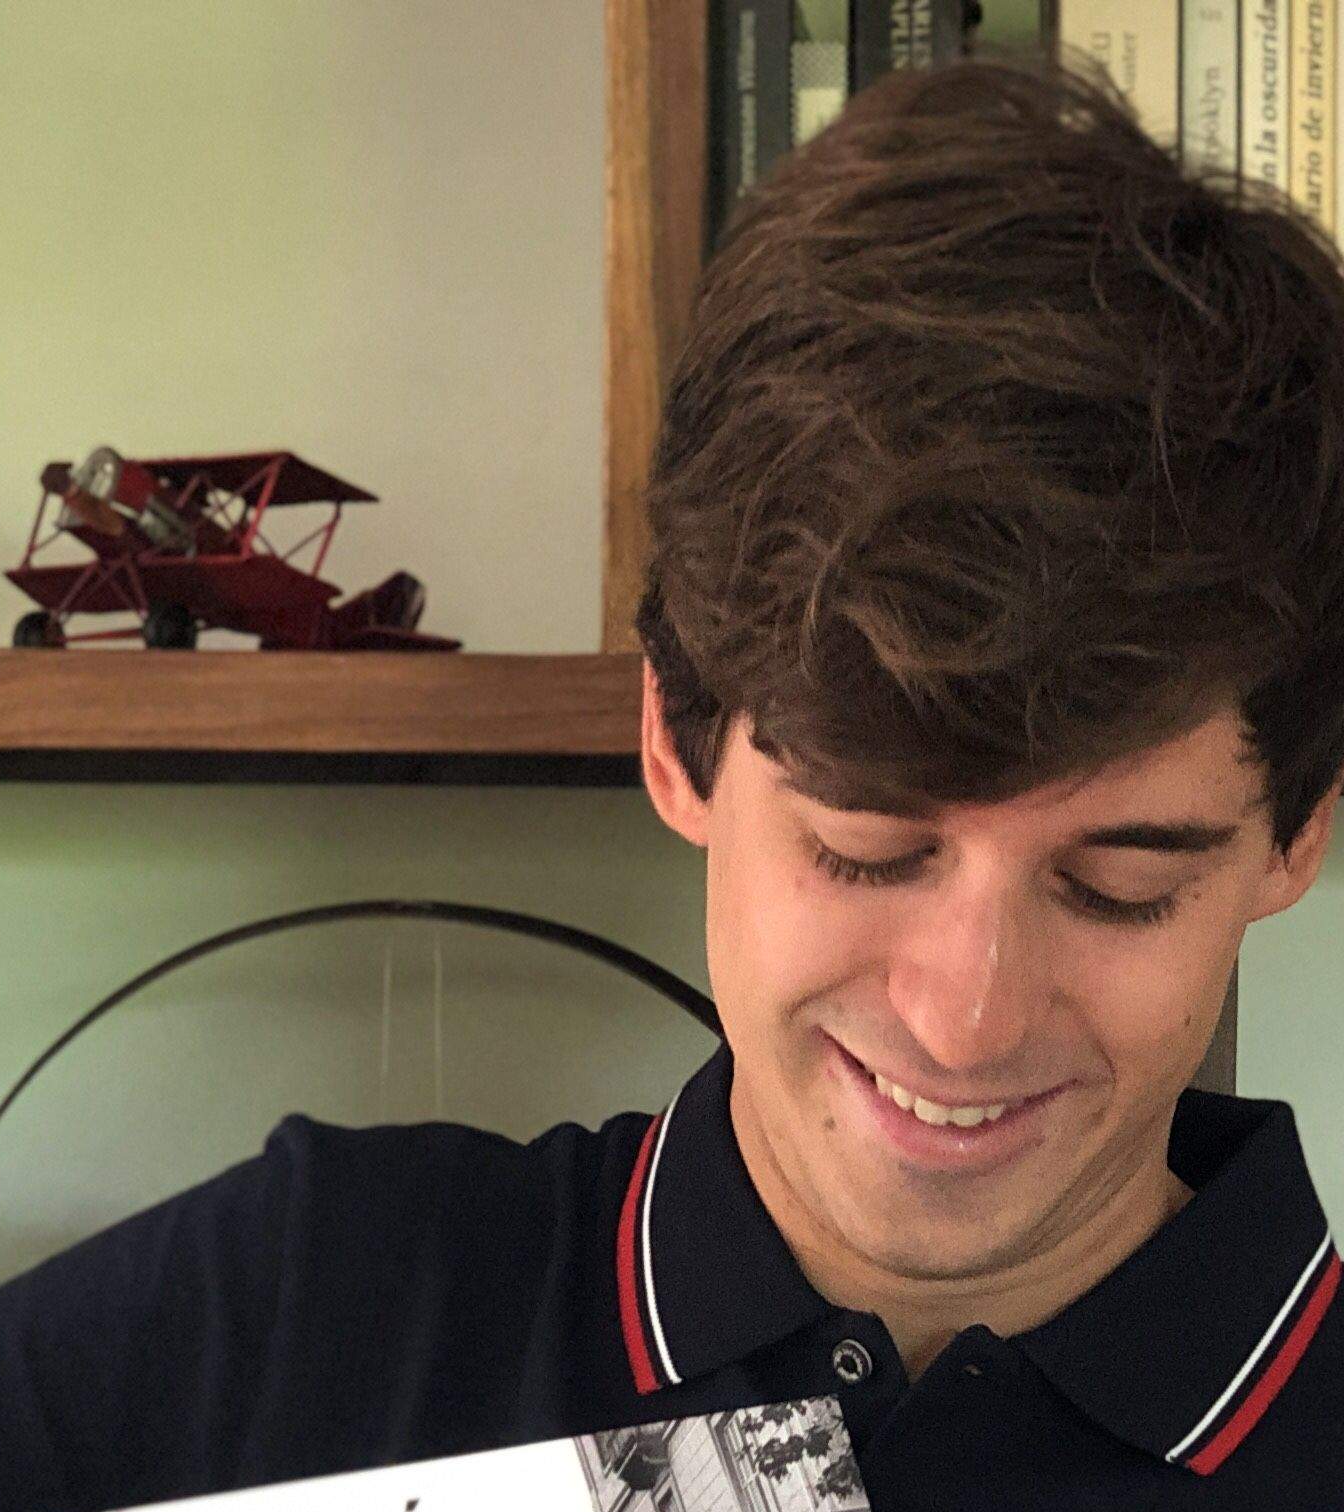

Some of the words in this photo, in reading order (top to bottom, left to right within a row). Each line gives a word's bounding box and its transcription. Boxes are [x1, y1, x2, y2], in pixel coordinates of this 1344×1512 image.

[1255, 0, 1279, 123] oscurida
[1303, 0, 1325, 101] inviern
[1302, 107, 1323, 142] de
